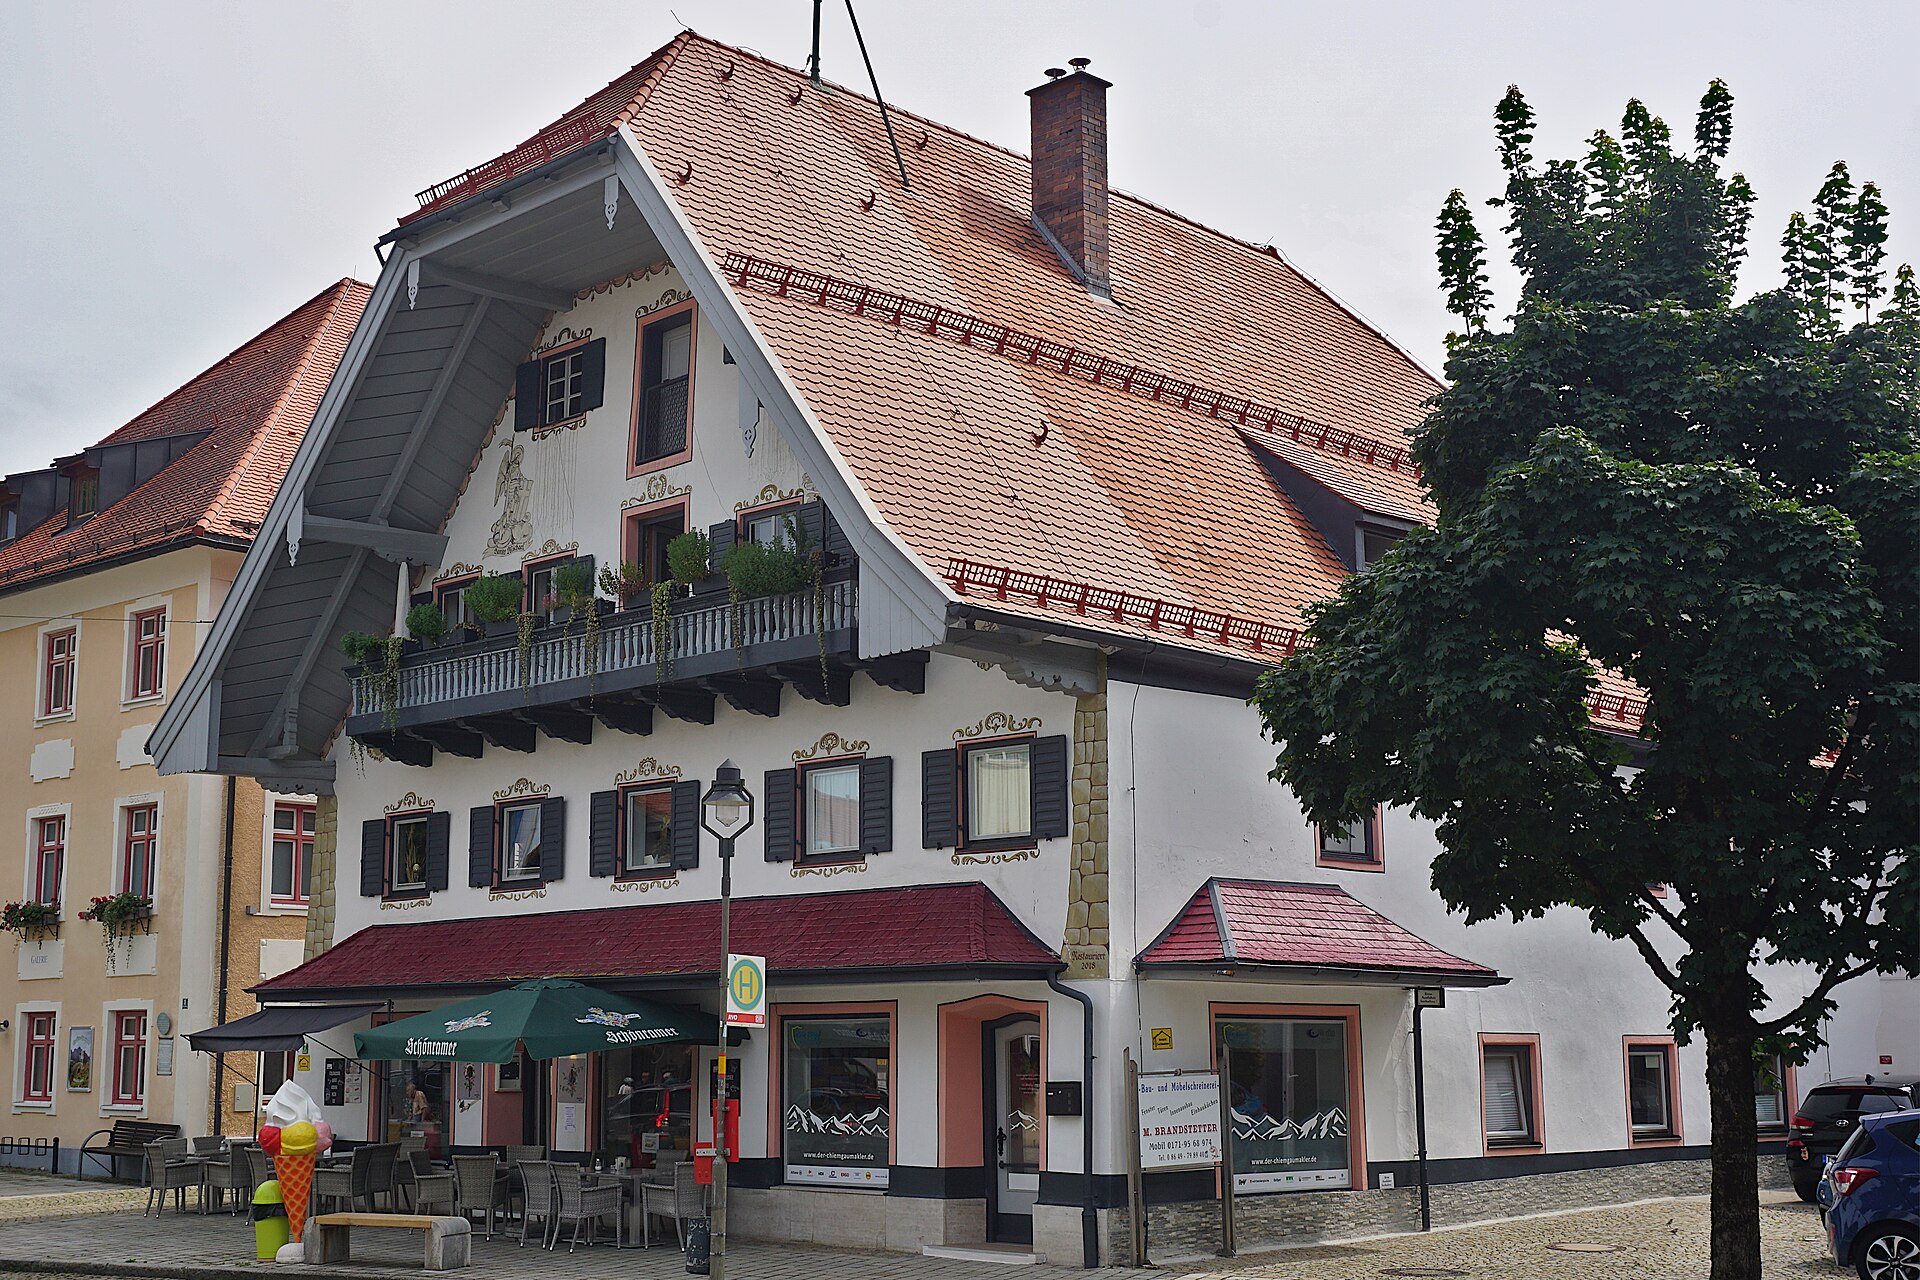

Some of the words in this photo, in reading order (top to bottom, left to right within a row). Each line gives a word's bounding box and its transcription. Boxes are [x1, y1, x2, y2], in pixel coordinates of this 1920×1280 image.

[1081, 962, 1096, 970] 2018
[739, 970, 753, 999] H
[604, 1027, 680, 1045] Schönramer
[404, 1037, 458, 1058] Schönramer
[1158, 1083, 1168, 1092] und
[1171, 1081, 1217, 1092] Möbelschreinerei
[1141, 1105, 1156, 1116] Fenster
[1157, 1105, 1169, 1115] Türen
[1169, 1101, 1193, 1116] Innenausbau
[1190, 1099, 1219, 1116] Einbauküchen
[1142, 1127, 1152, 1137] M.
[1154, 1123, 1218, 1136] BRANDSTETTER
[1149, 1141, 1166, 1151] Mobil
[1201, 1138, 1212, 1147] 974
[803, 1151, 875, 1161] www.der-chiemgaumakler.de
[1251, 1156, 1317, 1166] www.der-chiemgaumakler.de
